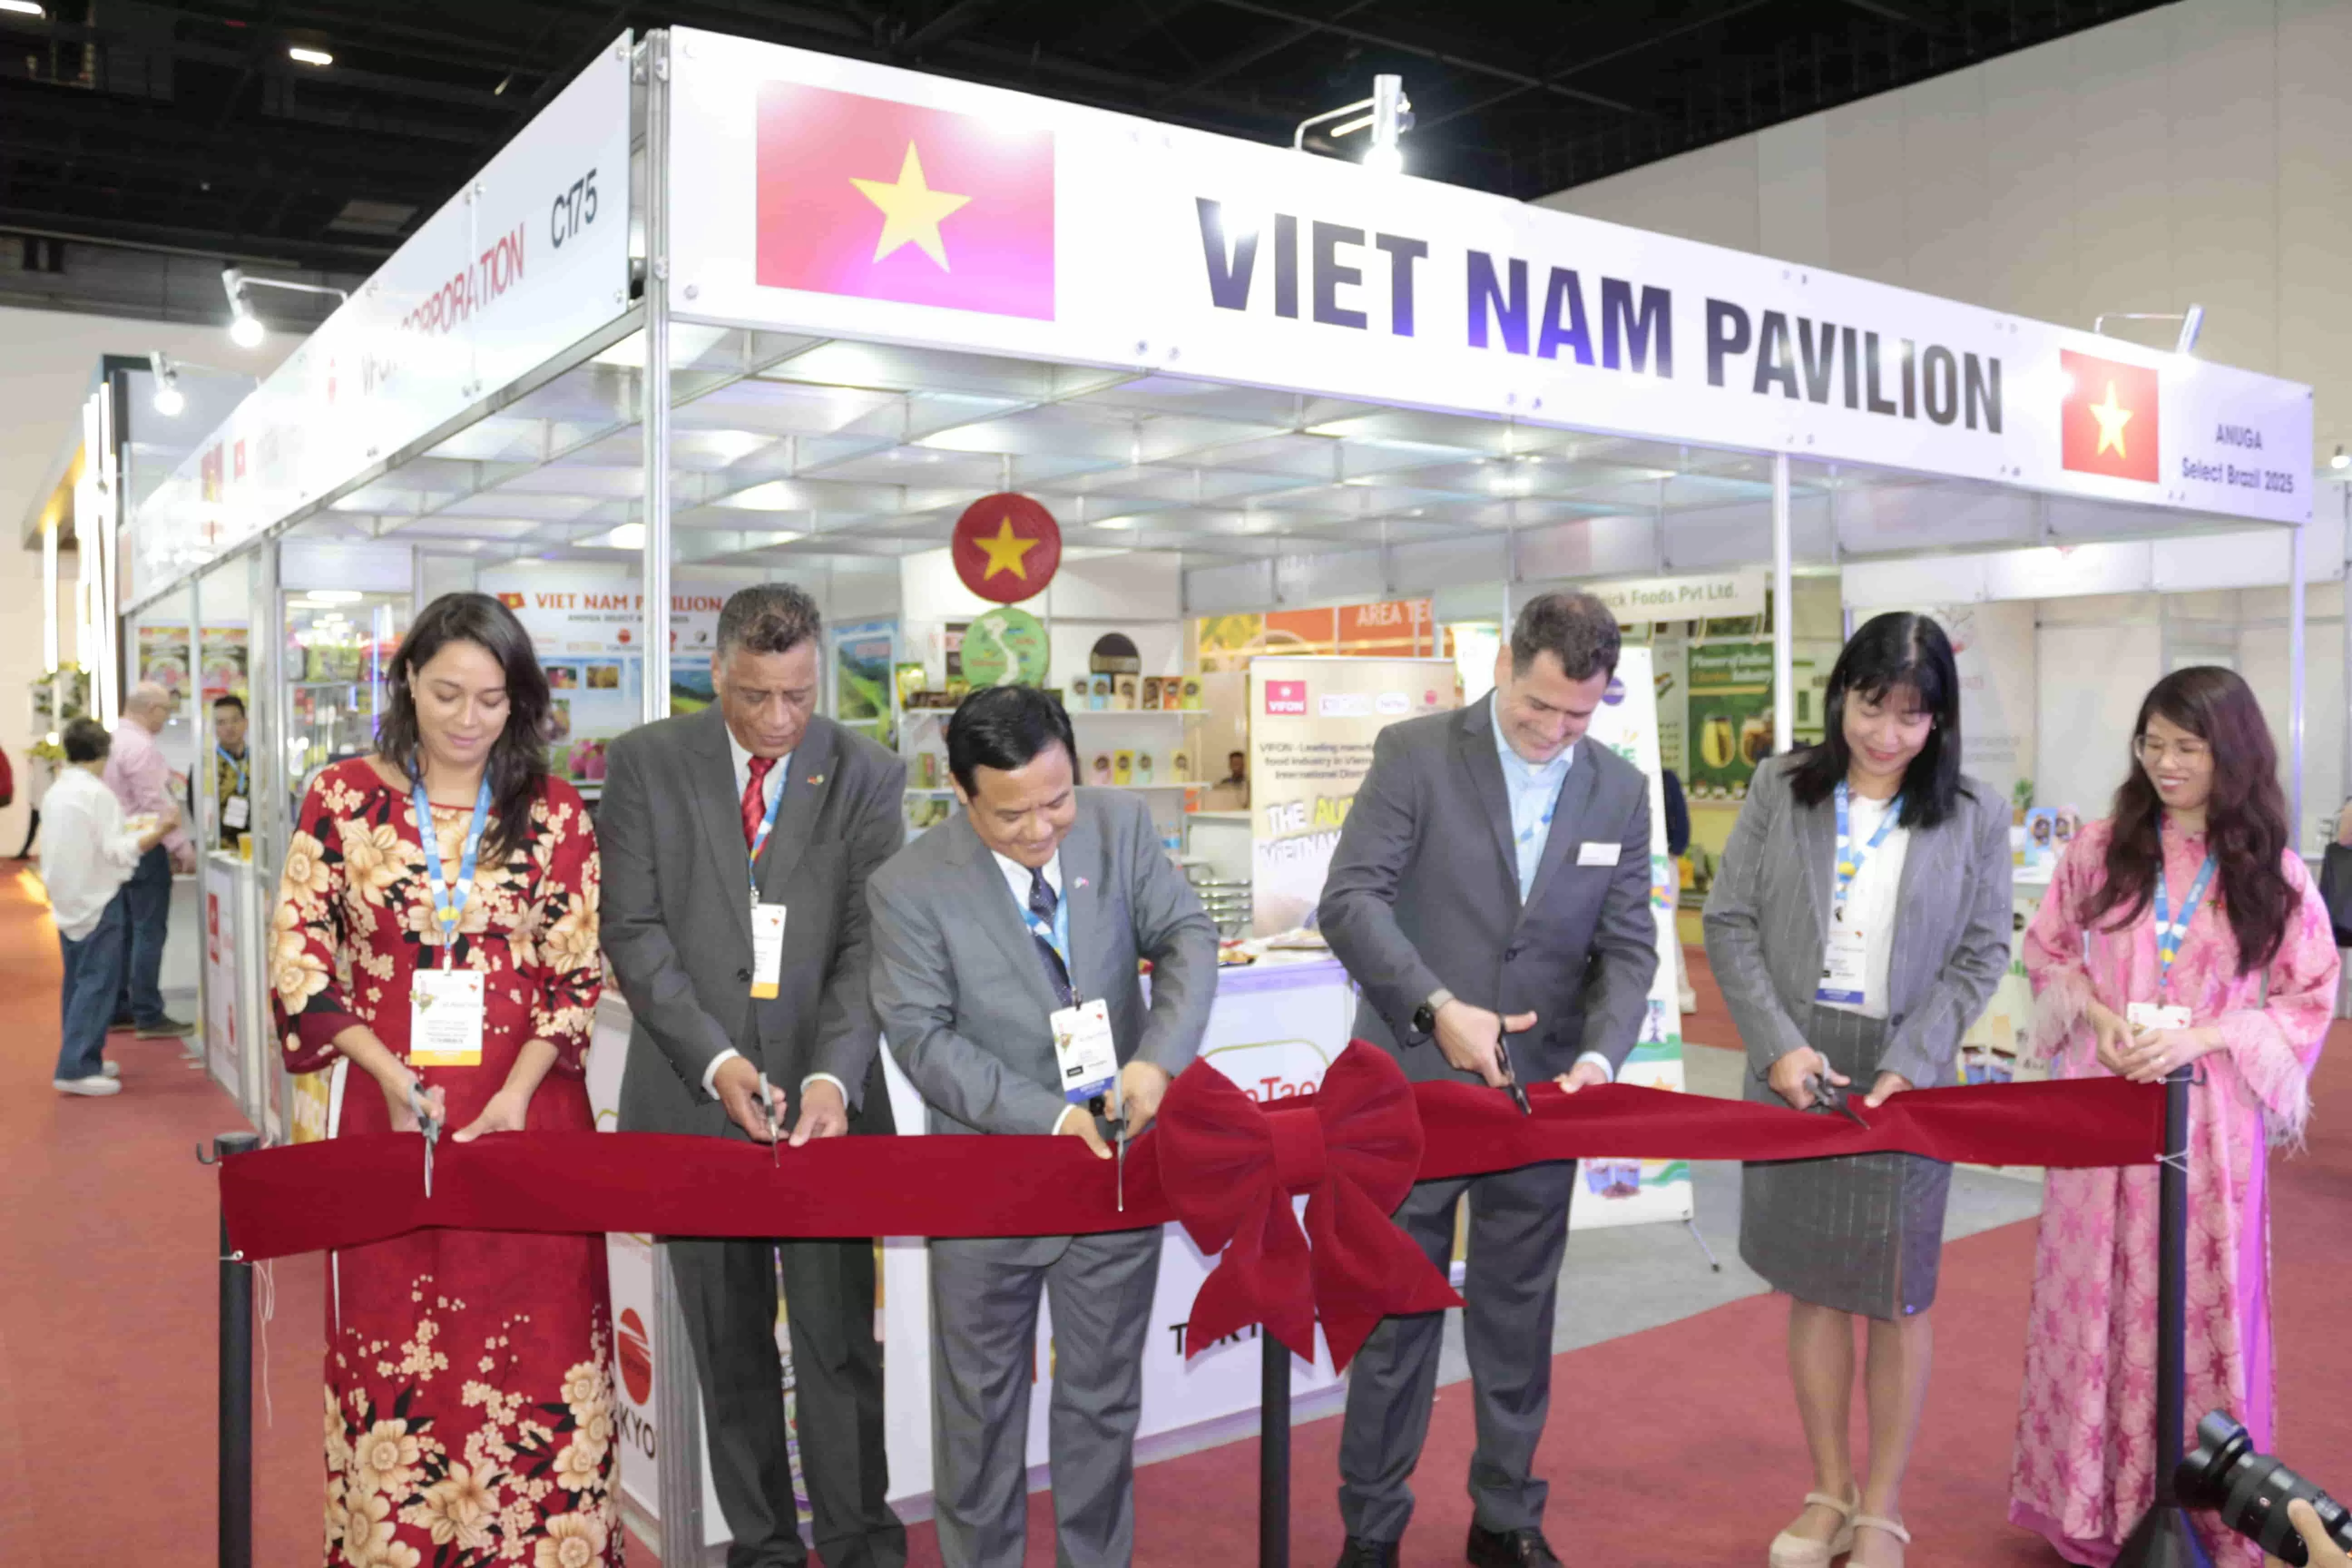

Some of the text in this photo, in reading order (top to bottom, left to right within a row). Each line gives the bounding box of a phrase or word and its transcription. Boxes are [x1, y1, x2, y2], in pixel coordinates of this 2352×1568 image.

[551, 167, 598, 250] C175
[1195, 196, 2002, 434] VIET NAM PAVILION
[2216, 423, 2263, 450] ANUGA
[2182, 456, 2294, 494] Select Brazil 2025
[535, 593, 723, 612] VIET NAM PILION
[1631, 588, 1674, 605] Foods
[1680, 585, 1703, 603] Pvt
[1708, 581, 1739, 600] Ltd.
[1357, 603, 1402, 626] AREA
[1269, 701, 1304, 712] VIFON
[1266, 800, 1307, 836] THE
